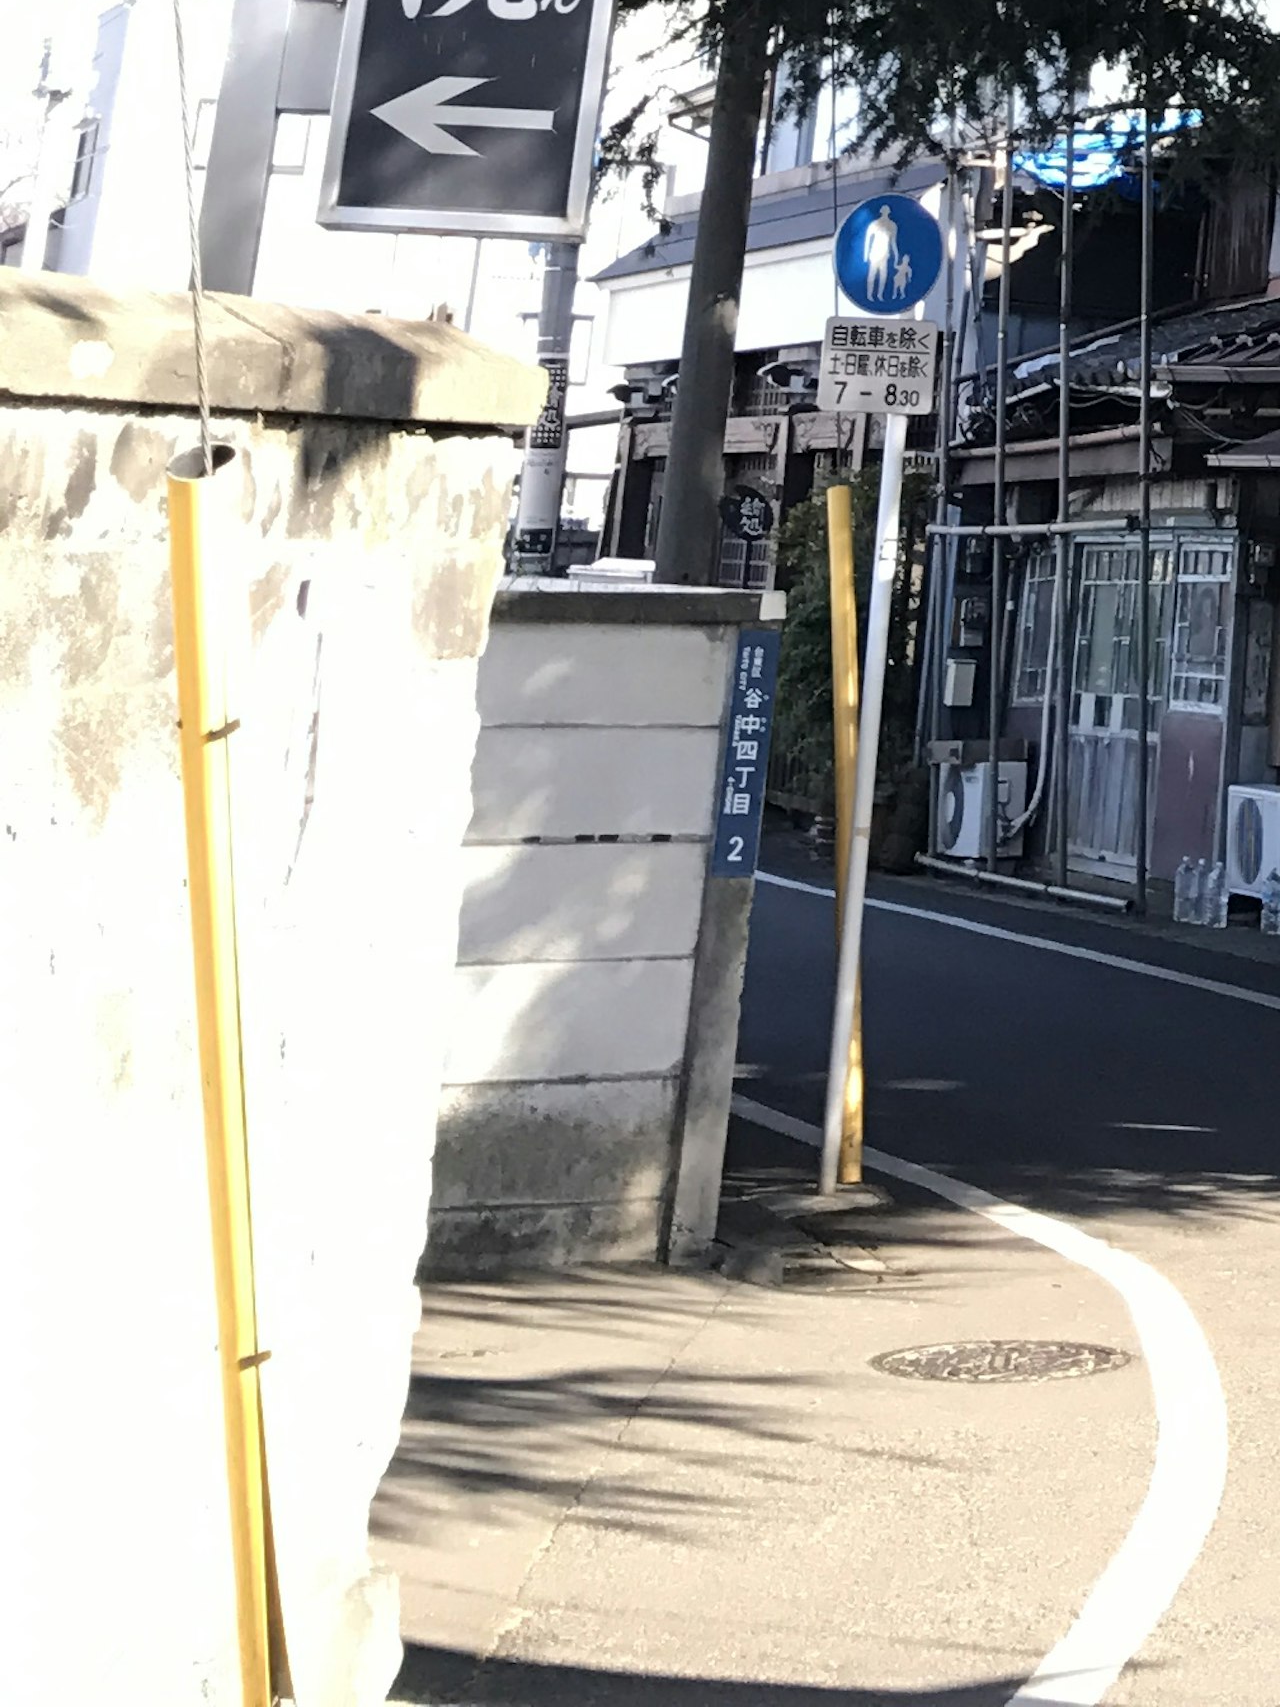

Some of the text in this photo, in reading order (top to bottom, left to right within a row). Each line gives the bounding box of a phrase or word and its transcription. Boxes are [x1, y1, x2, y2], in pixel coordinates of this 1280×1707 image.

[831, 324, 931, 349] 自転車を除く
[834, 381, 848, 404] 7
[726, 687, 763, 862] 谷中四丁目 2
